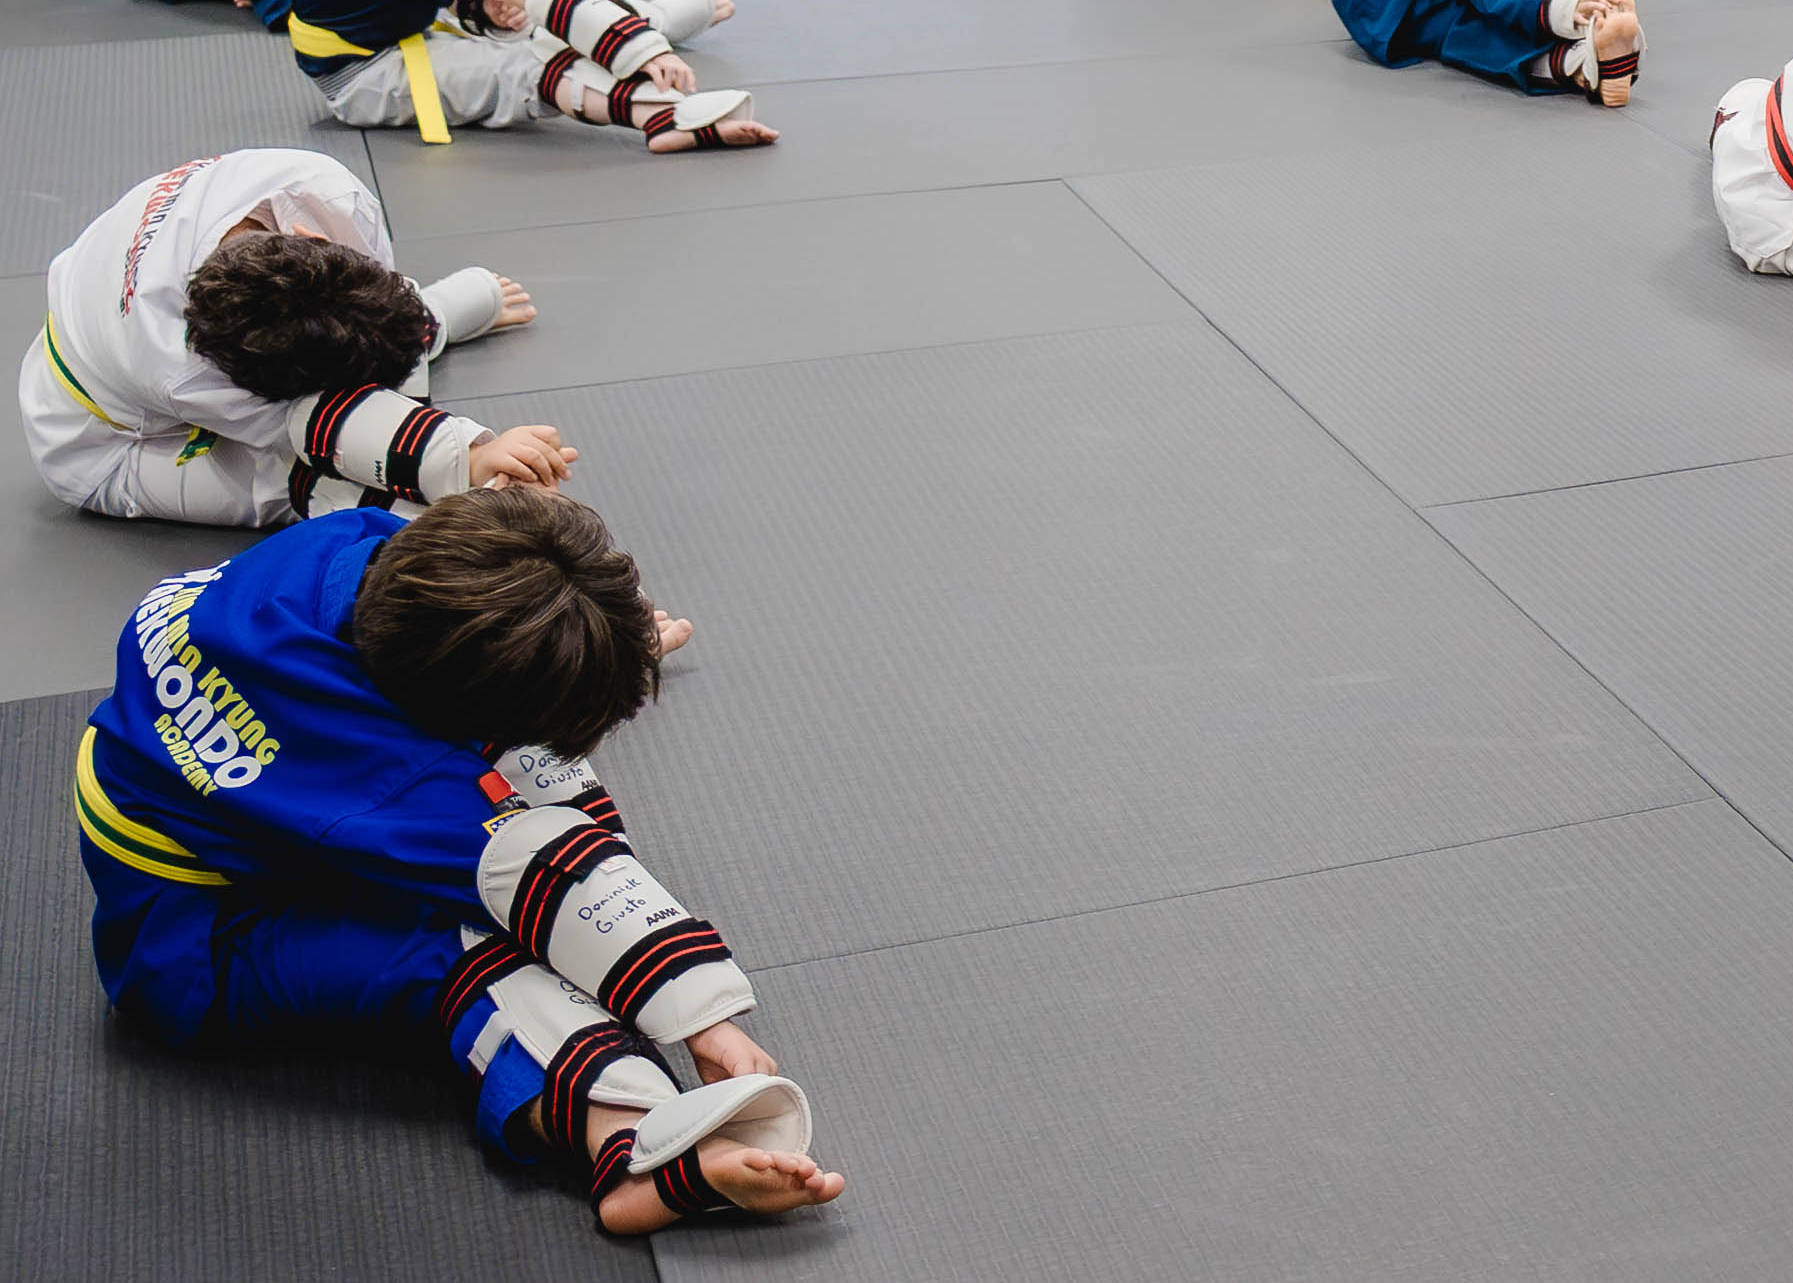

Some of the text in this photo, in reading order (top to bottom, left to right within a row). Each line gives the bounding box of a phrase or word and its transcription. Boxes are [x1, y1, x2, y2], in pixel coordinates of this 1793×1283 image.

[197, 666, 281, 765] KYUNG
[153, 713, 218, 797] ACADEMY
[535, 767, 585, 790] Giusto
[578, 877, 642, 923] Dominick
[594, 897, 647, 935] Giusto
[645, 907, 680, 927] AAMA
